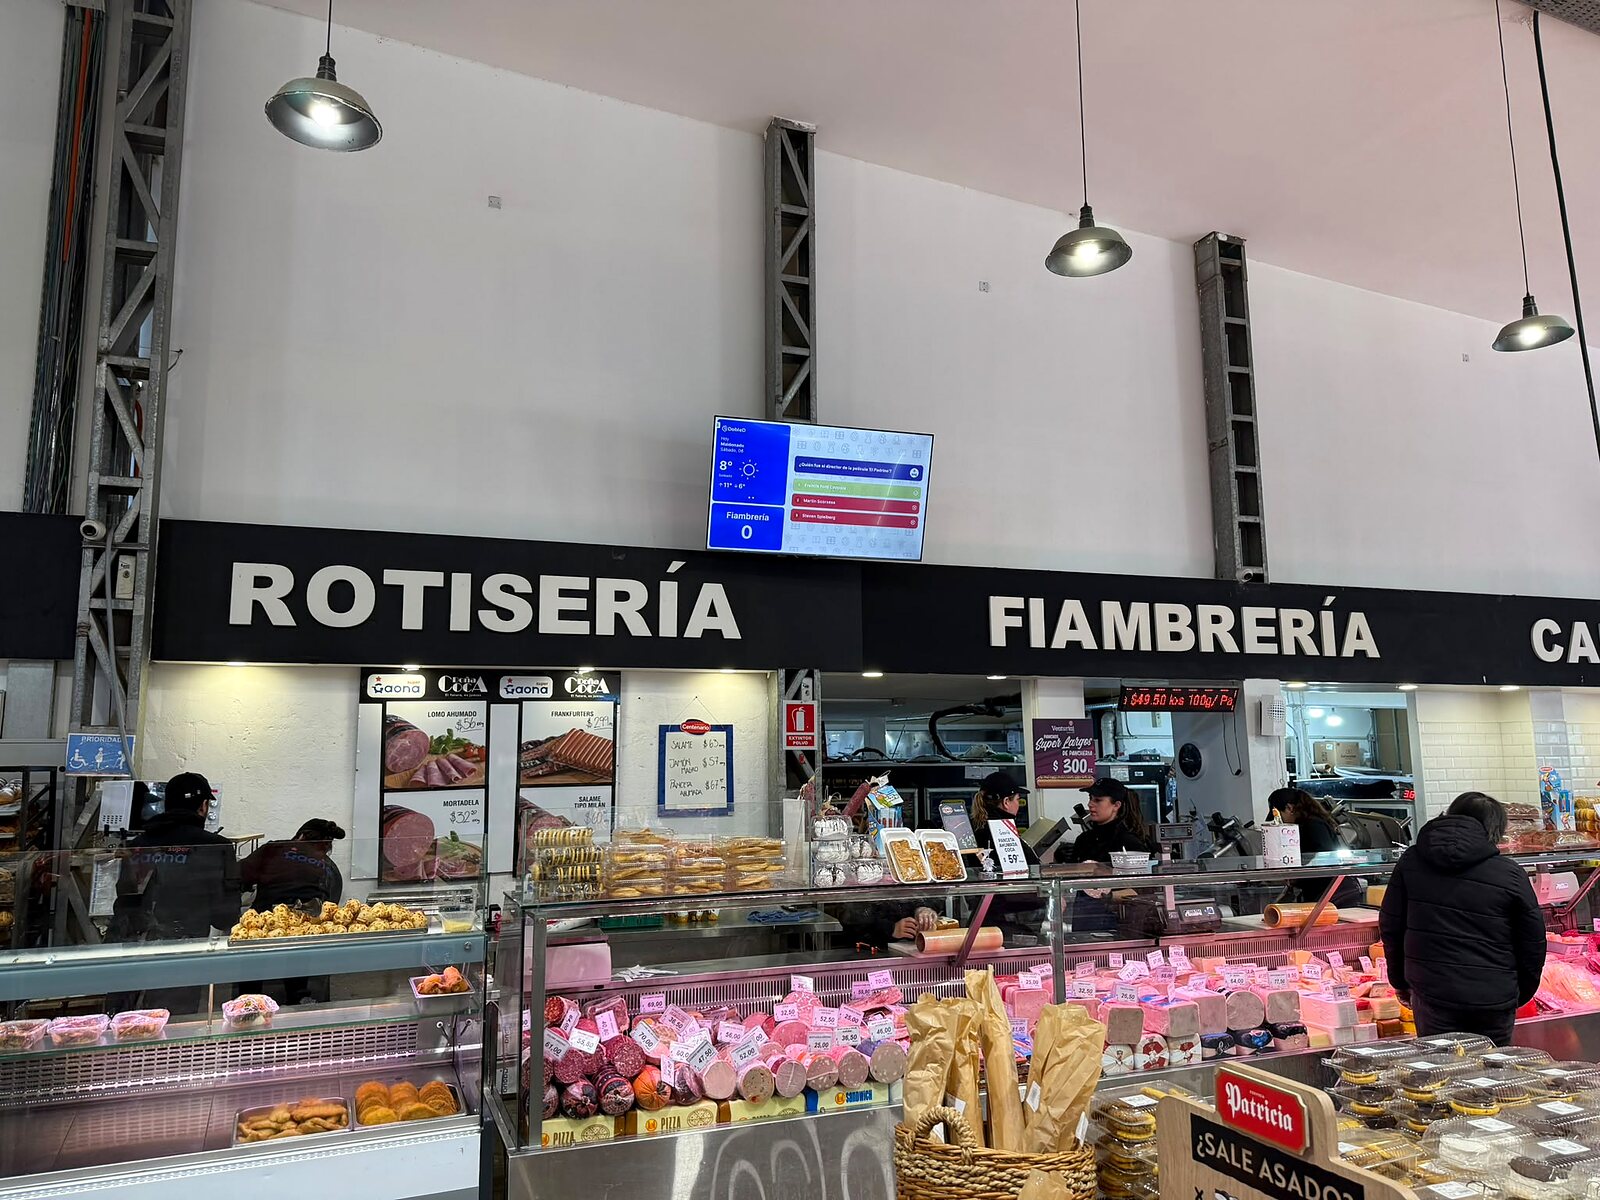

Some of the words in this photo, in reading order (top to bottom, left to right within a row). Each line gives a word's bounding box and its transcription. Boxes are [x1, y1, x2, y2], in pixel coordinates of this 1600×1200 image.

[720, 461, 733, 471] 8°
[726, 511, 770, 521] Fiambrería
[741, 524, 753, 540] 0
[228, 560, 743, 641] ROTISERÍA
[988, 595, 1381, 659] FIAMBRERÍA
[1530, 618, 1600, 664] CA
[504, 684, 548, 694] Gaona
[671, 741, 693, 750] SALAME
[1035, 737, 1062, 751] Super
[1061, 736, 1093, 749] Largos
[1052, 760, 1059, 772] $
[1063, 758, 1088, 774] 300
[443, 799, 480, 807] MORTADELA
[1008, 854, 1018, 863] 59
[1225, 1082, 1293, 1132] Patricia
[660, 1115, 681, 1130] PIZZA
[553, 1131, 575, 1147] PIZZA
[1196, 1132, 1254, 1174] ¿SALE
